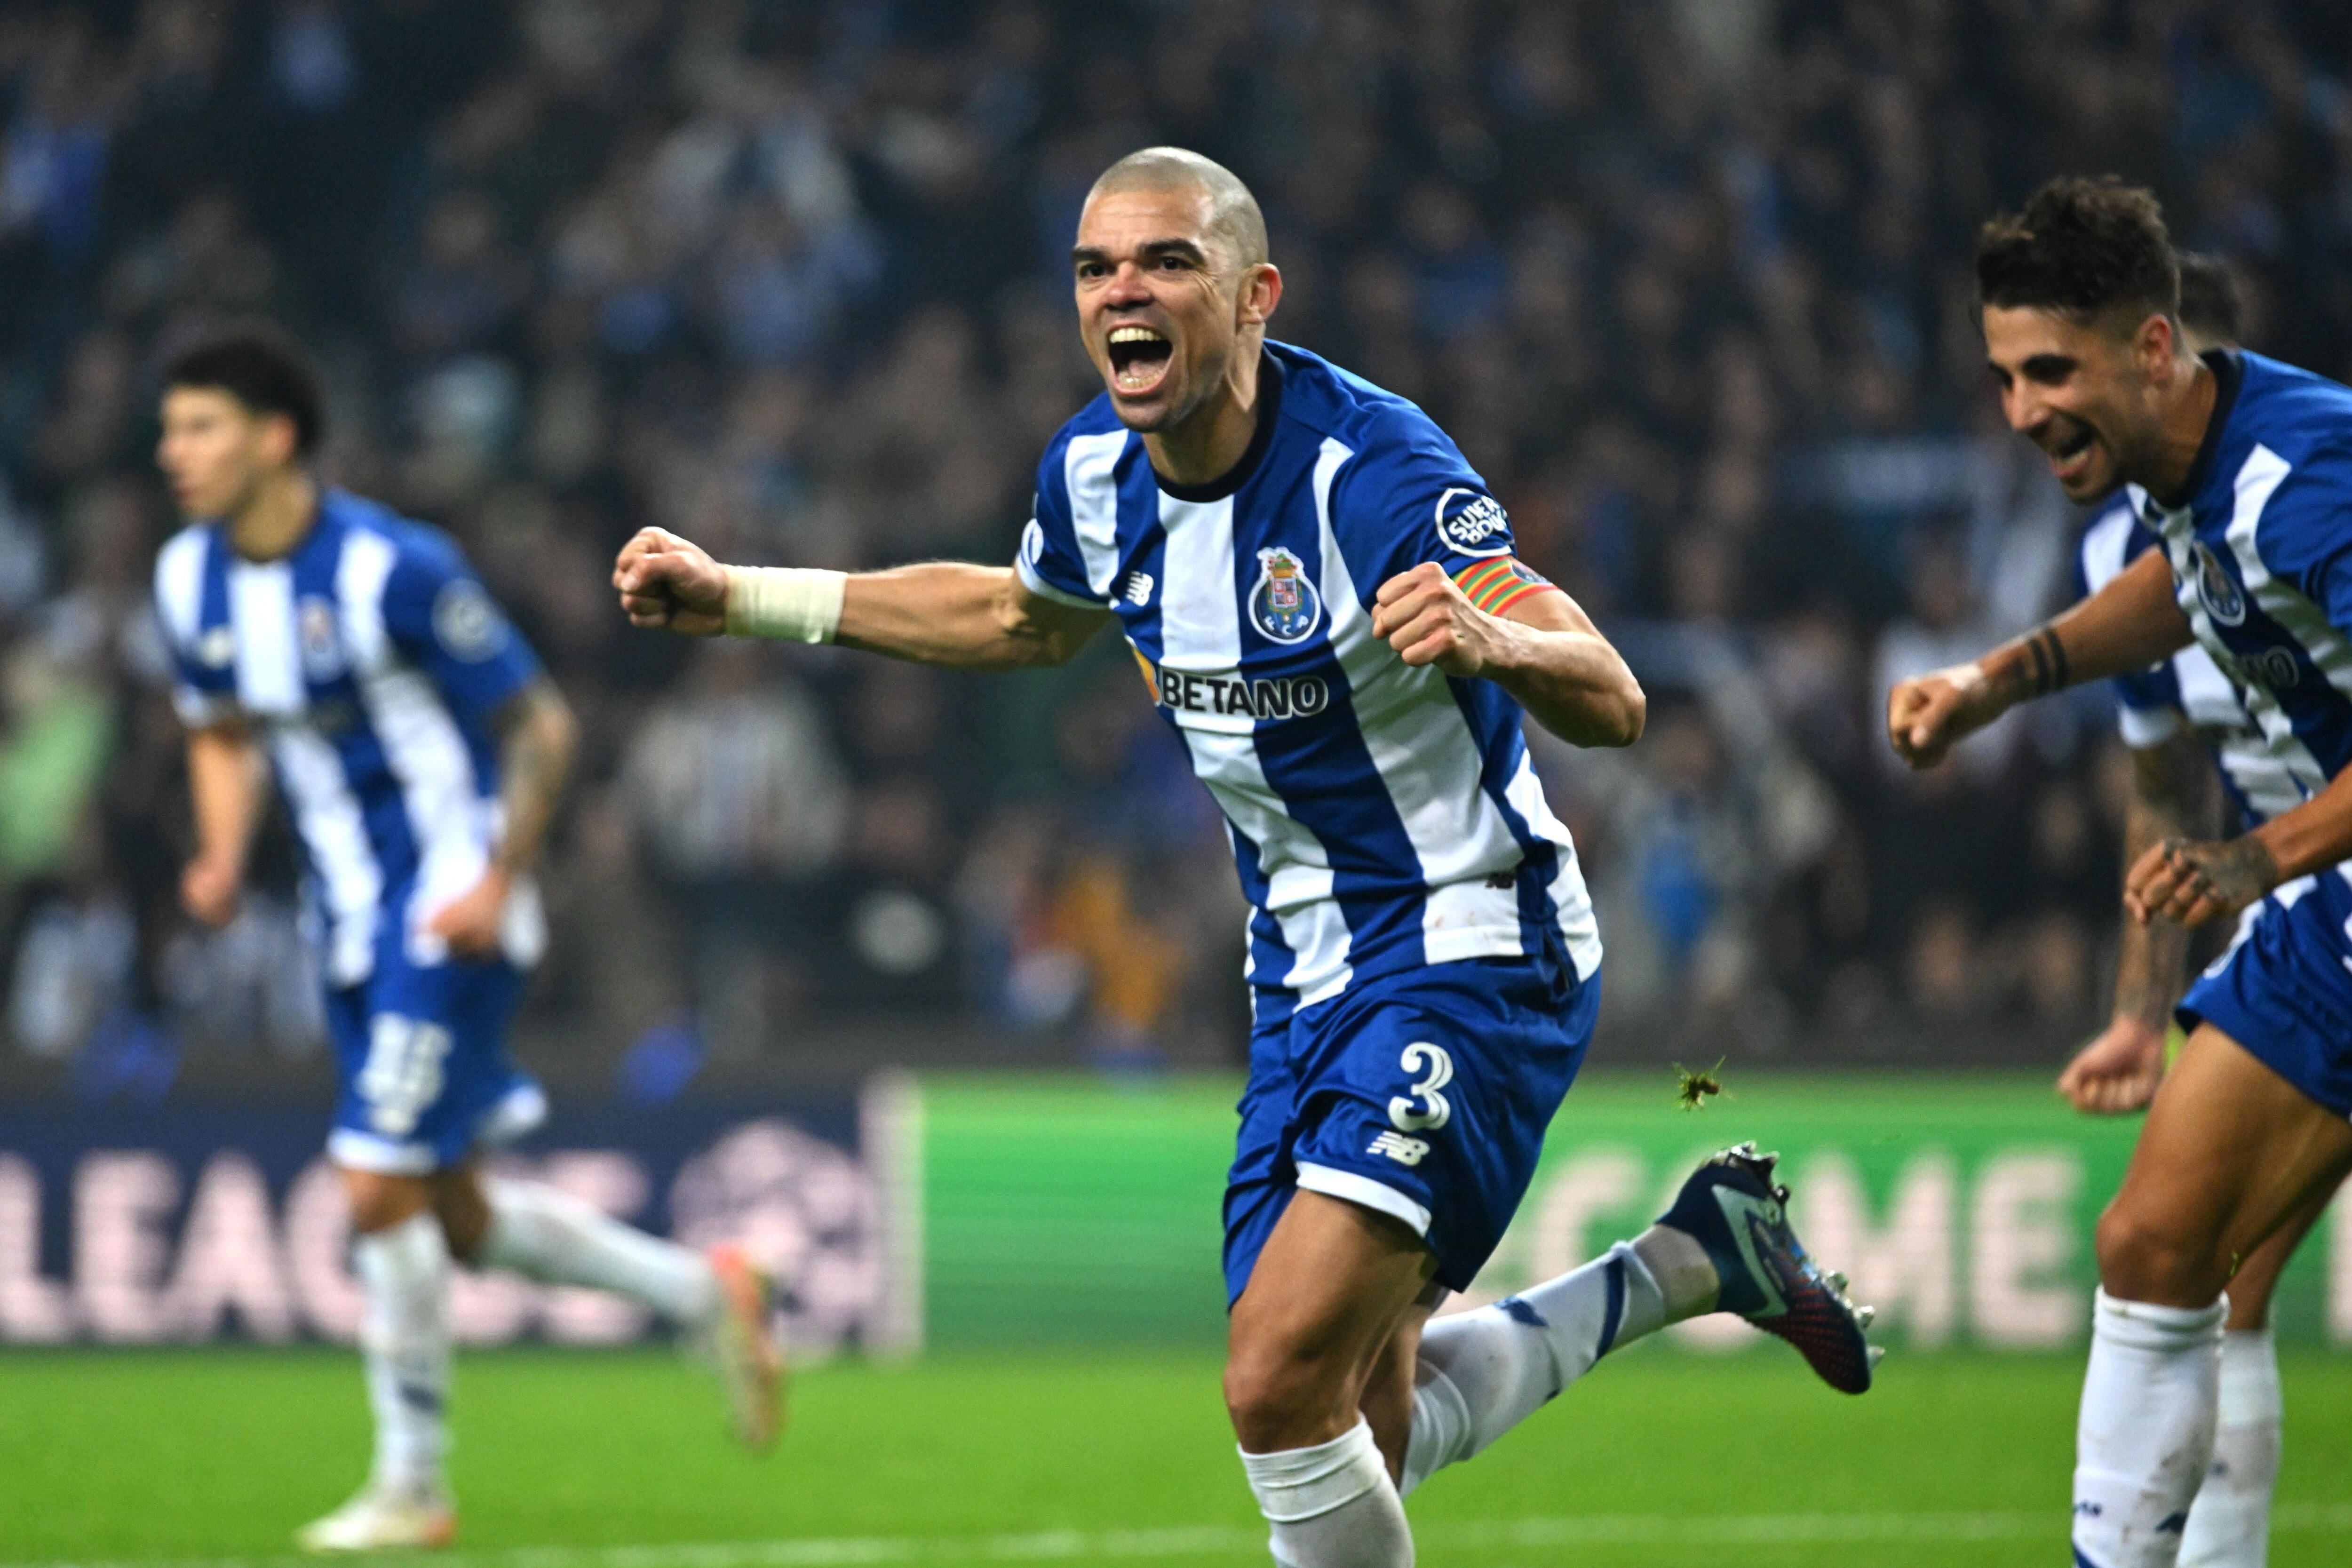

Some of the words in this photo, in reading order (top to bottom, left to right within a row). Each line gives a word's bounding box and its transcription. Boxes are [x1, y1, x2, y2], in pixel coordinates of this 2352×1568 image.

[1160, 667, 1329, 720] BETANO
[1388, 1041, 1454, 1130] 3
[0, 1148, 652, 1343] LEAE
